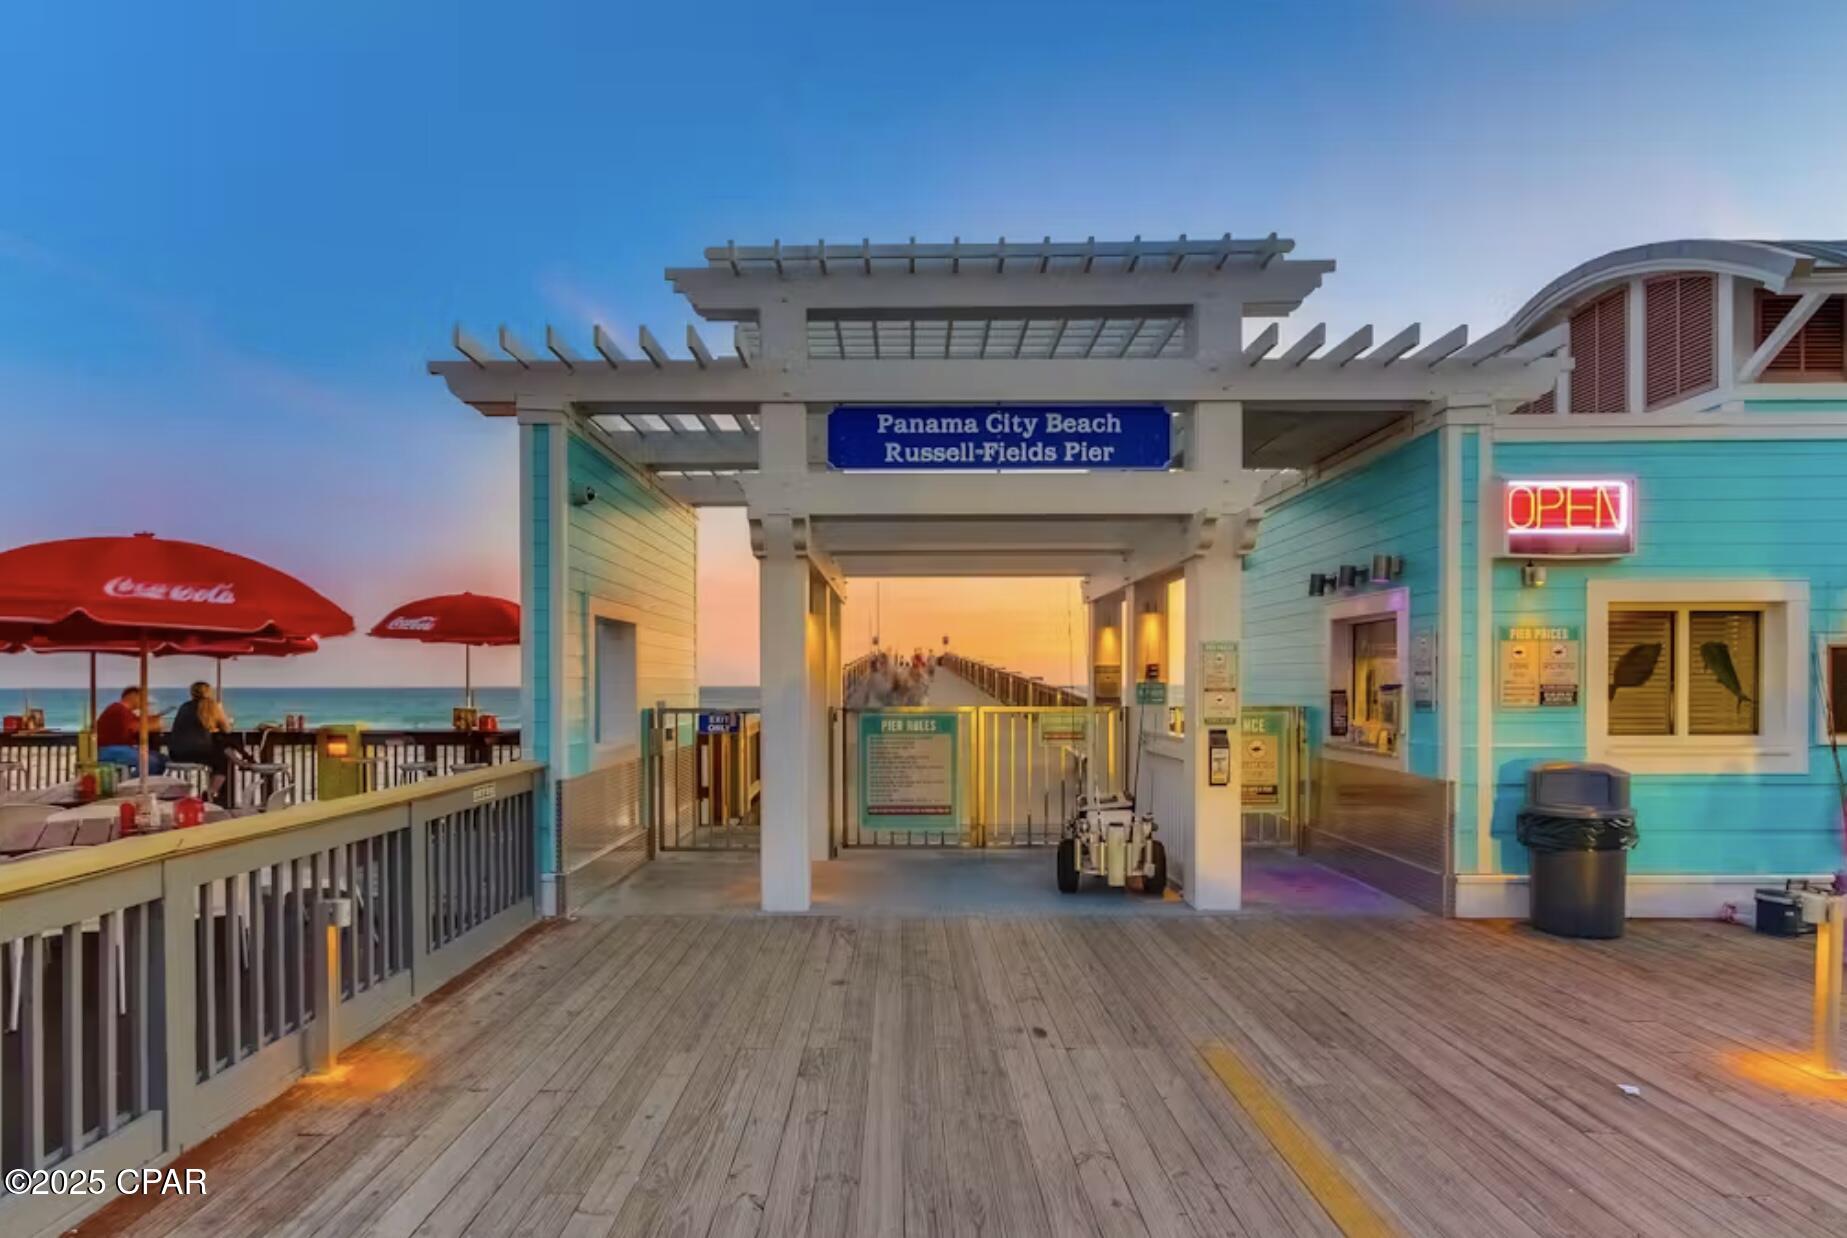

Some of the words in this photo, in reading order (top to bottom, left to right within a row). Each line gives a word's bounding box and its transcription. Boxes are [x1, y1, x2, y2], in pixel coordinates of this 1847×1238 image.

[877, 414, 979, 434] Panama
[985, 413, 1039, 438] City
[1045, 413, 1122, 434] Beach
[884, 442, 1057, 463] Russell-Fields
[1064, 442, 1115, 463] Pier
[1508, 485, 1625, 530] OPEN
[881, 719, 903, 731] PIER
